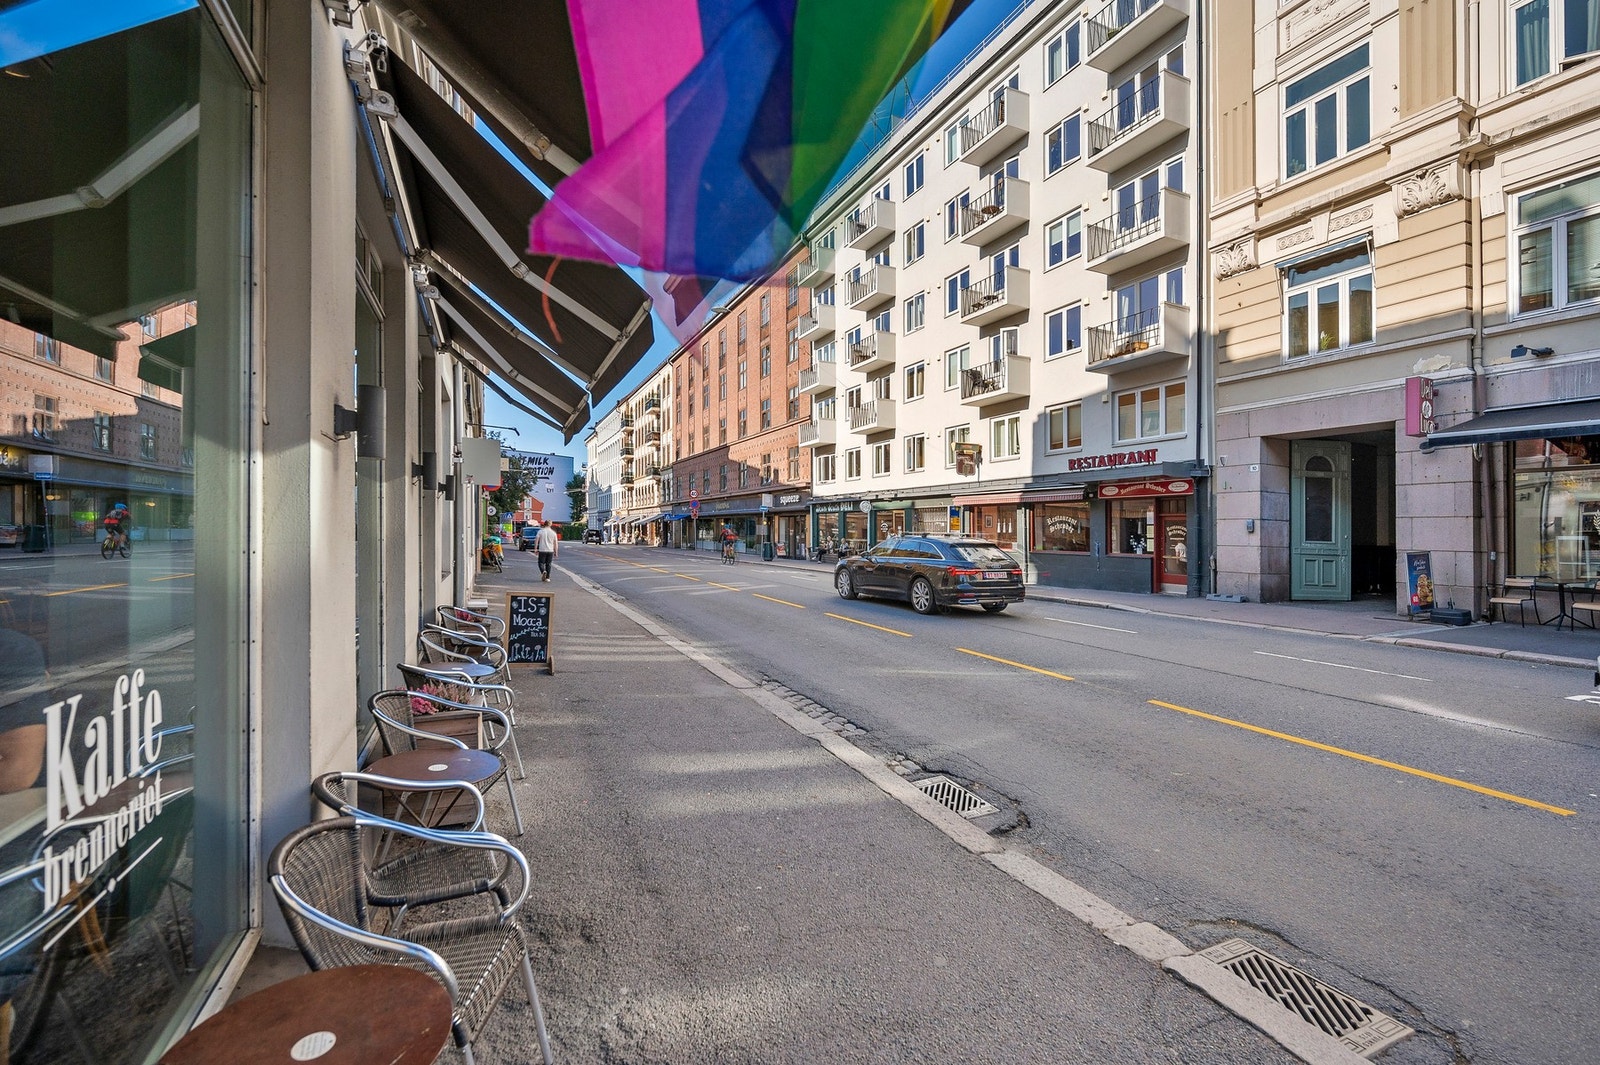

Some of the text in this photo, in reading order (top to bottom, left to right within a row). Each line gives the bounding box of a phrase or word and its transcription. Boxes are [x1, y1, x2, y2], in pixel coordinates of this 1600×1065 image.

[527, 456, 549, 466] MILK
[1068, 448, 1158, 471] RESTAURANT
[1046, 515, 1078, 526] Restaurant
[517, 596, 545, 613] IS-
[513, 613, 542, 627] Mocca
[42, 667, 163, 836] Kaffe
[42, 769, 163, 914] brenneriet
